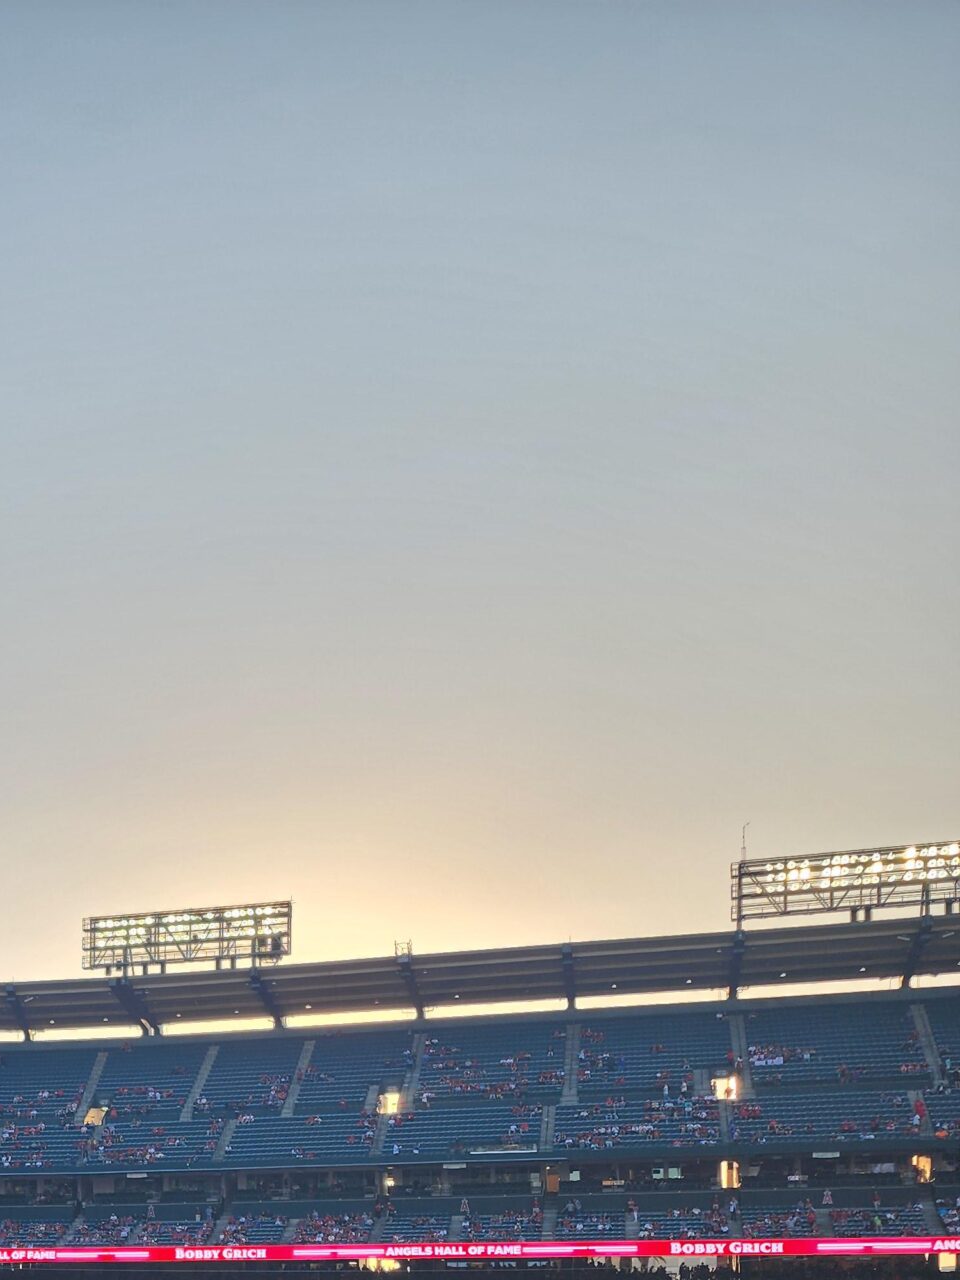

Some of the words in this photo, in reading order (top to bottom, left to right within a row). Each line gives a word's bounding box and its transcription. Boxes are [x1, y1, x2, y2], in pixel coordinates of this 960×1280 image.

[175, 1247, 220, 1259] BOBBY
[222, 1248, 266, 1259] GRICH
[385, 1247, 433, 1256] ANGELS
[434, 1246, 466, 1255] HALL
[468, 1246, 486, 1255] OF
[487, 1245, 522, 1255] FAME
[670, 1242, 726, 1254] BOBBY
[729, 1242, 784, 1253] GRICH
[11, 1251, 25, 1259] OF
[27, 1250, 56, 1259] FAME
